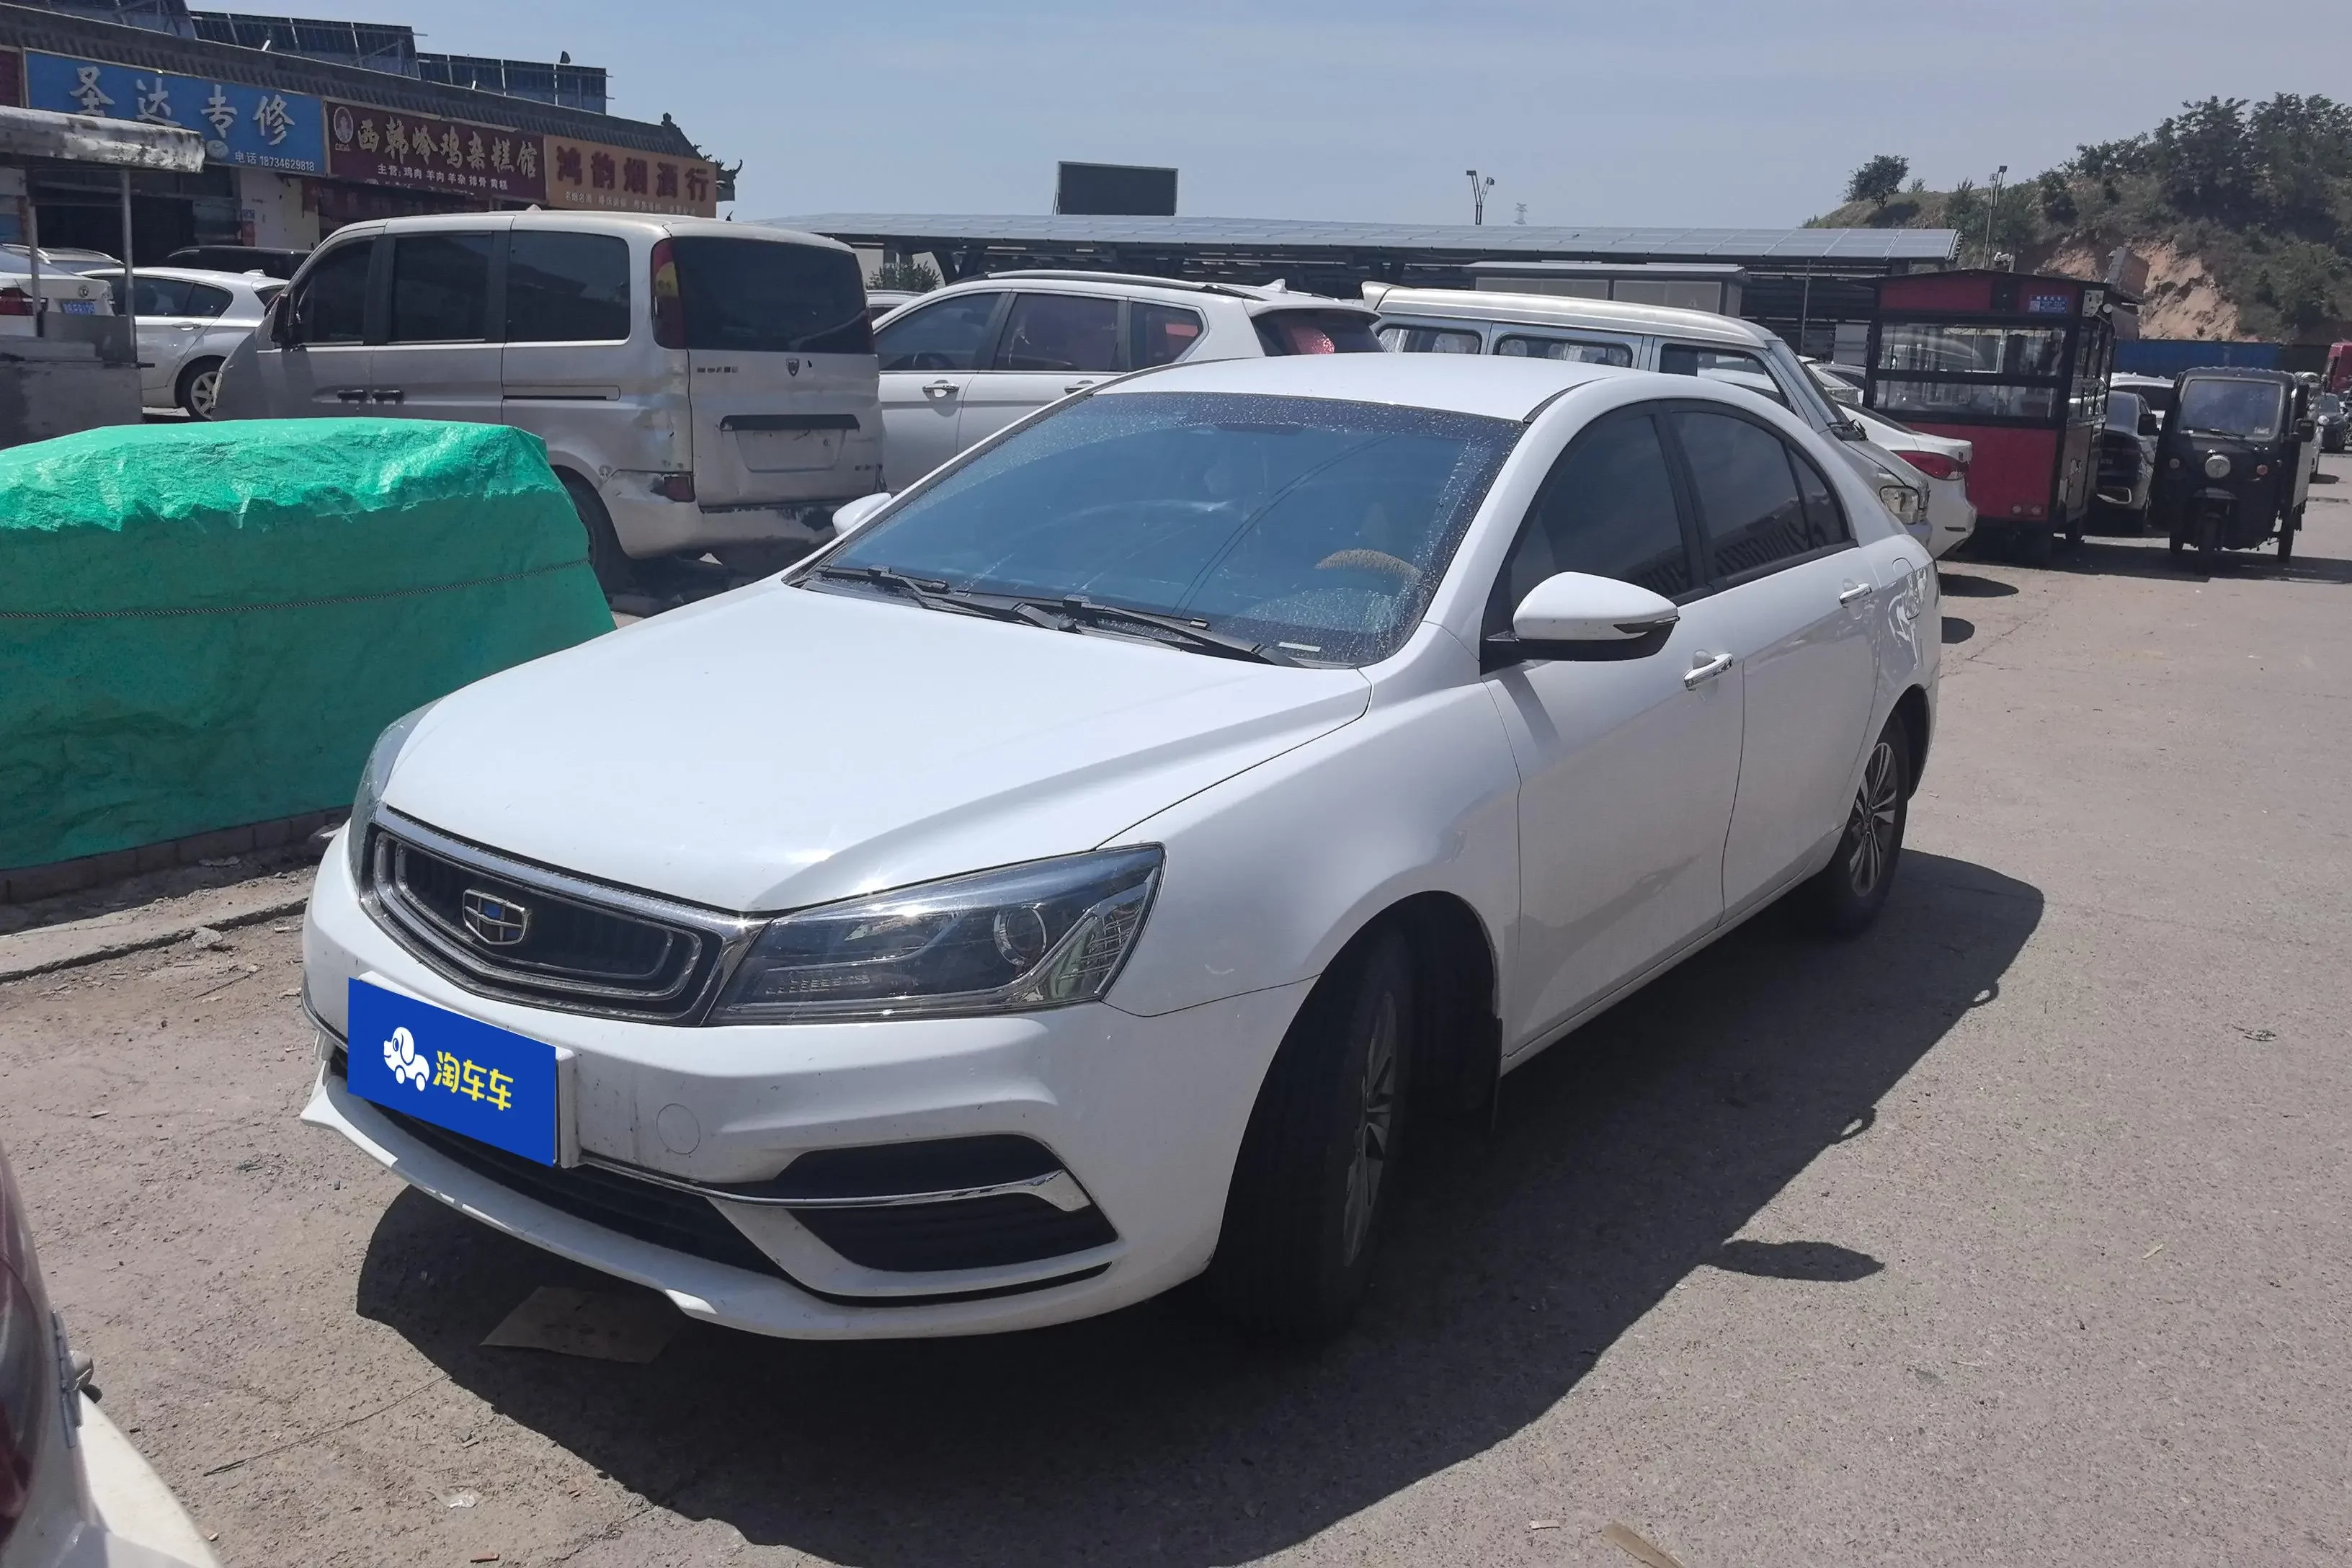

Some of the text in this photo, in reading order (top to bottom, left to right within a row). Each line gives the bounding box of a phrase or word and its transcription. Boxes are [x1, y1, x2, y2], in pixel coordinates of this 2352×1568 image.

[70, 66, 295, 146] 圣达专修
[235, 151, 315, 171] 电话 18734629818
[426, 169, 445, 183] 羊肉
